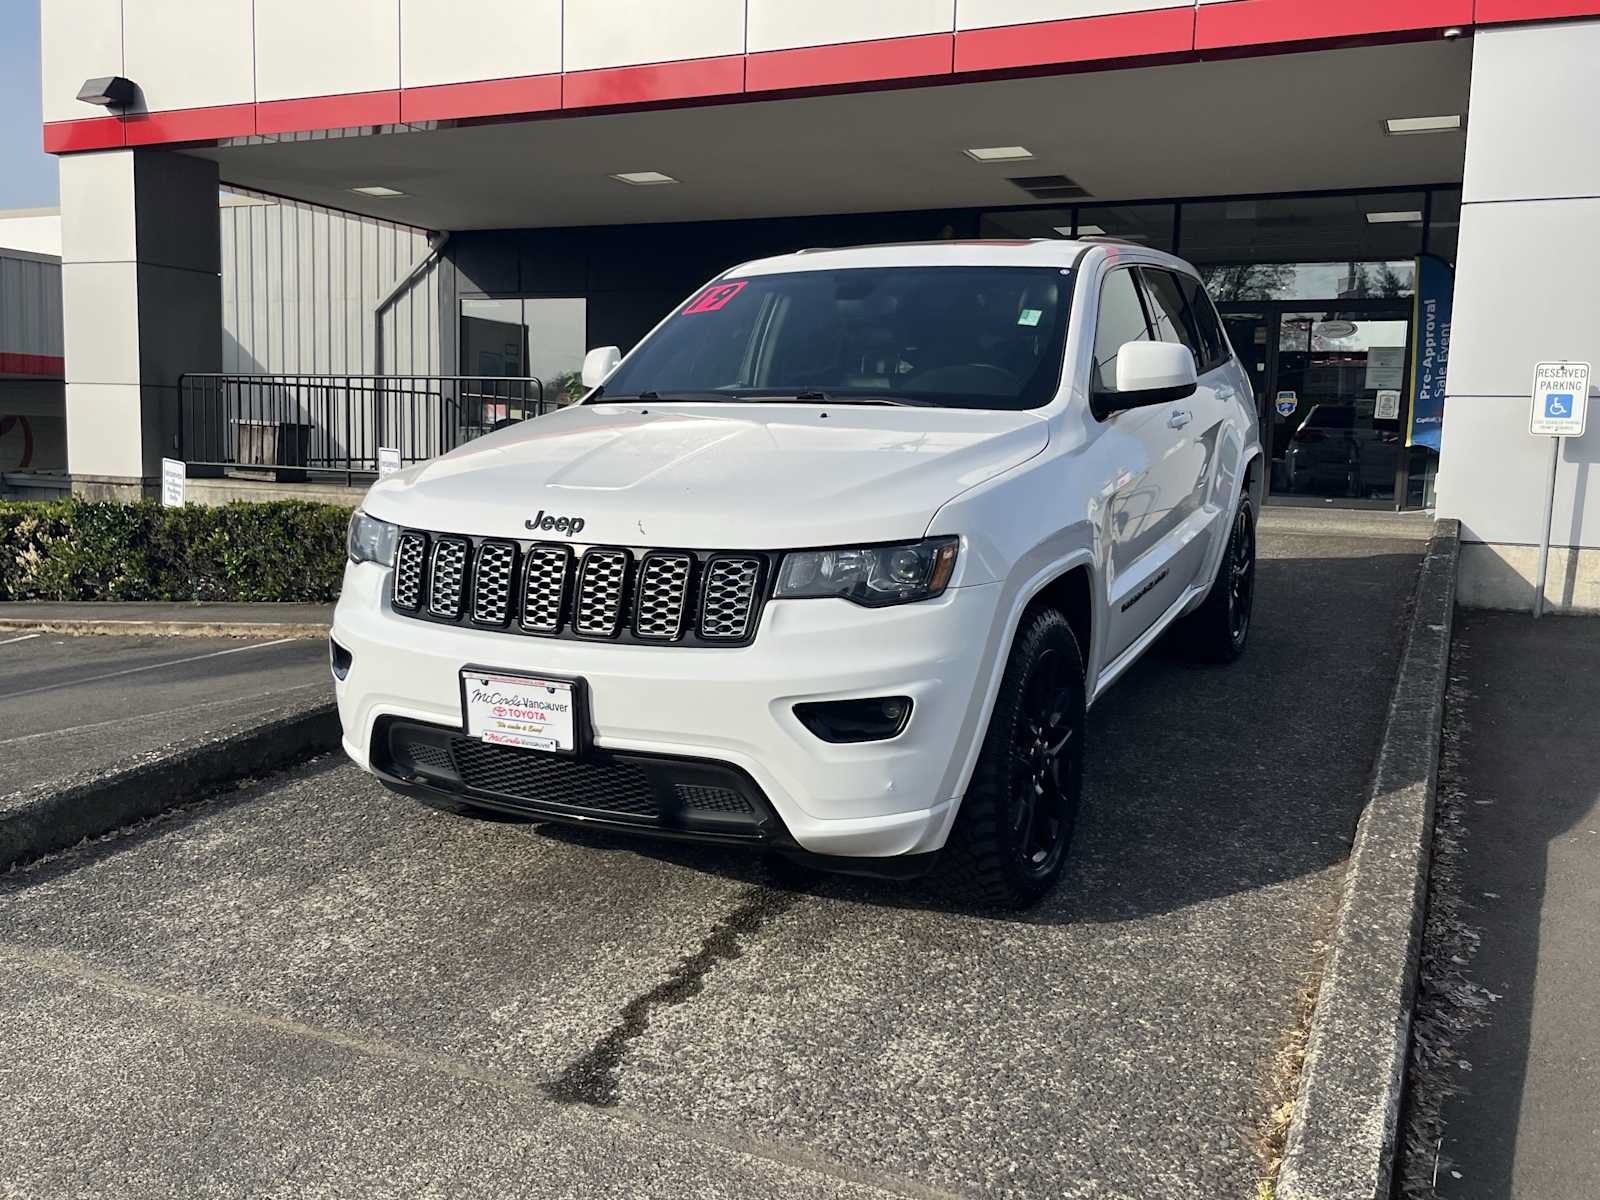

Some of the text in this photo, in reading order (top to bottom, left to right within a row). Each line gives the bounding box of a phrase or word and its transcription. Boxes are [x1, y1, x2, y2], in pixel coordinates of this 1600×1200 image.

[1419, 298, 1437, 400] Pre-Approval
[1434, 322, 1451, 398] Sale Event
[1537, 368, 1586, 379] RESERVED
[1540, 380, 1582, 391] PARKING
[524, 510, 585, 537] Jeep
[508, 708, 547, 721] TOYOTA
